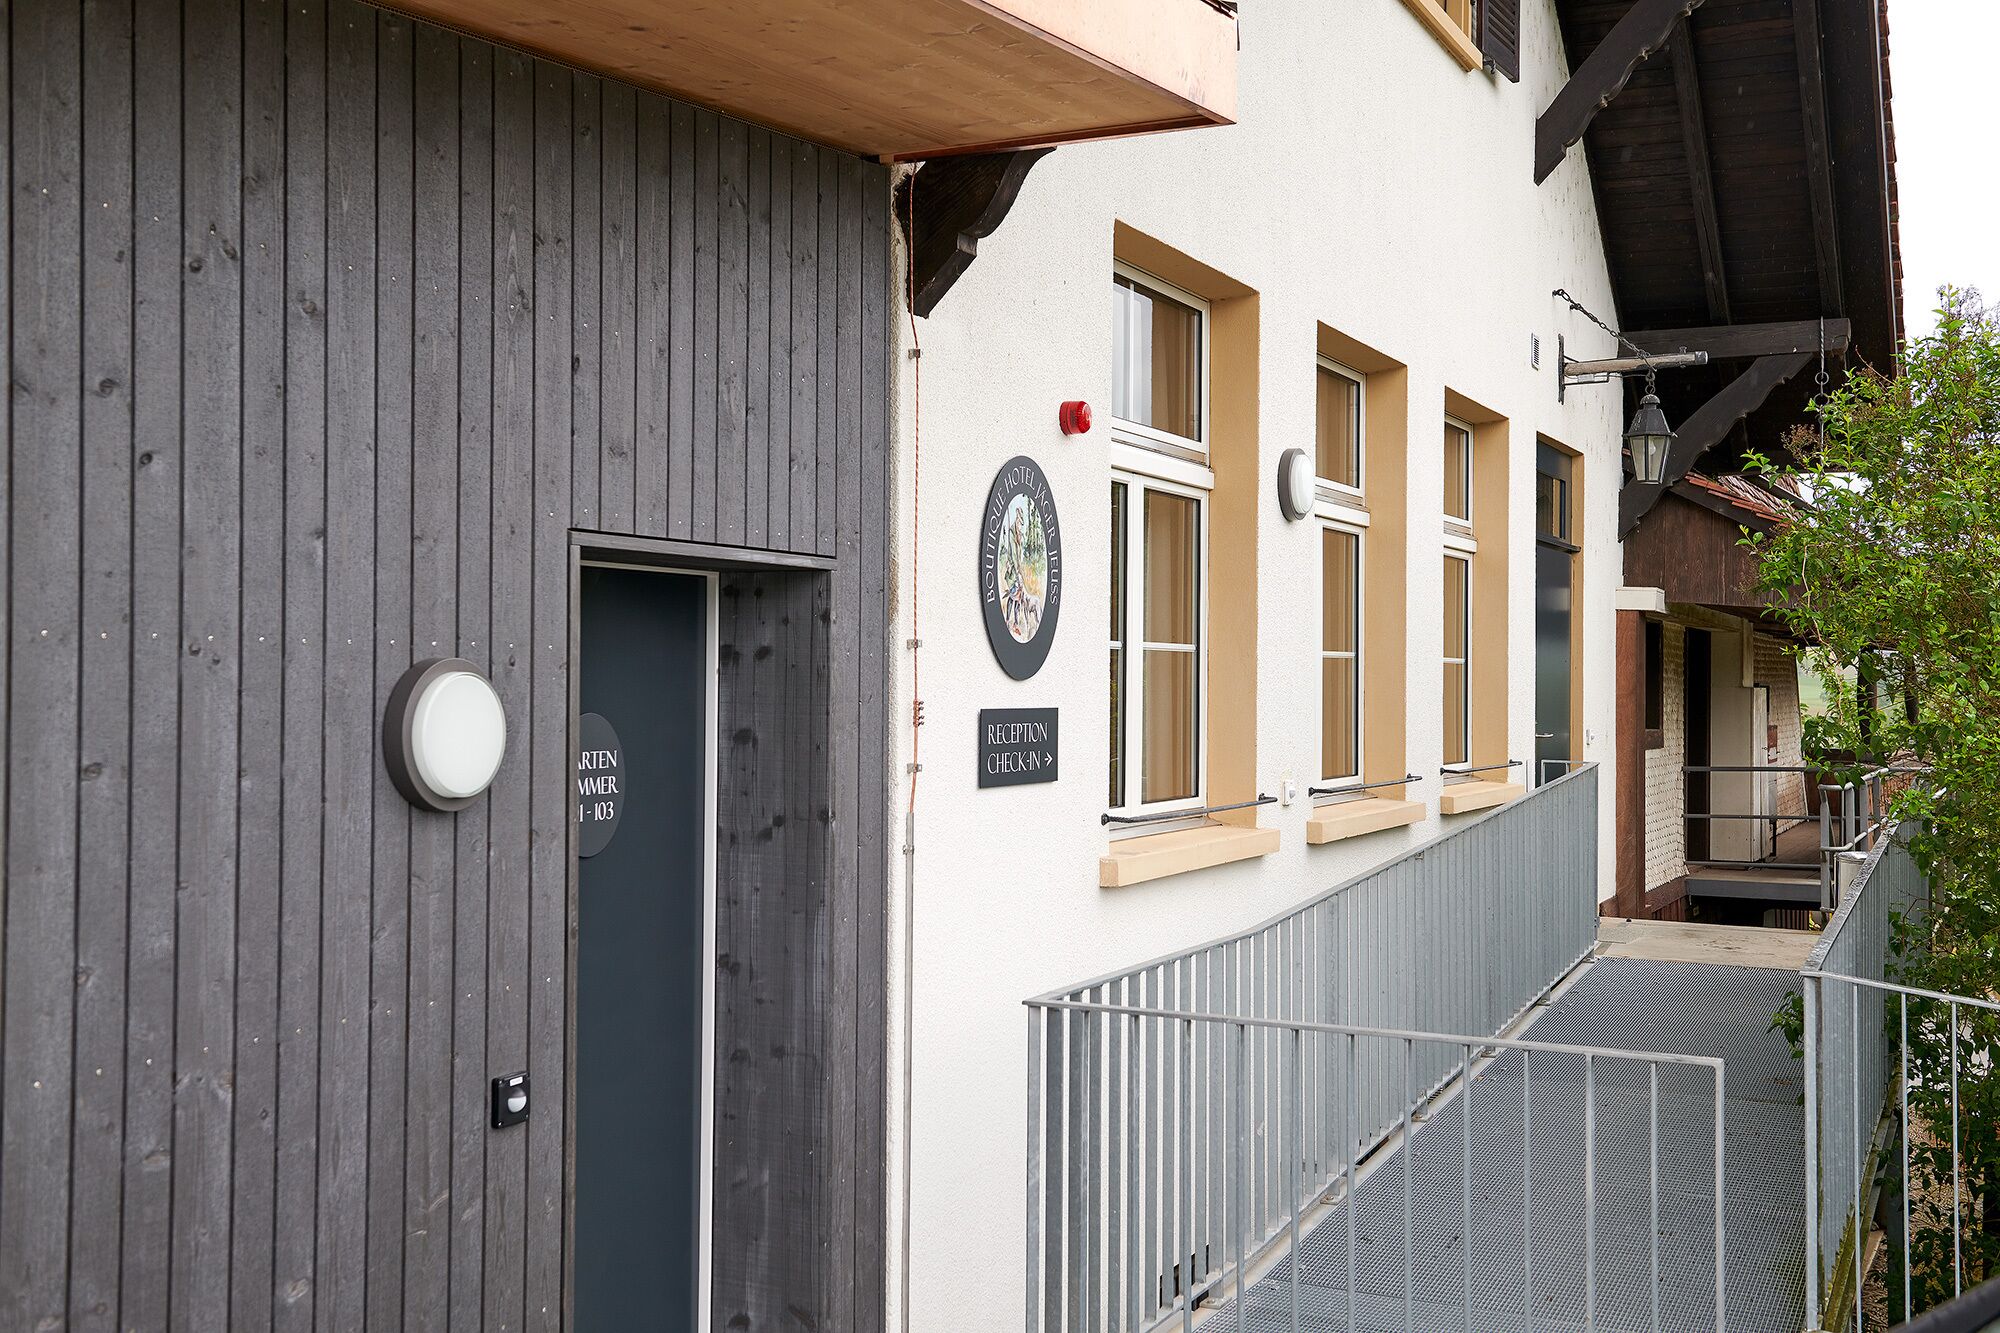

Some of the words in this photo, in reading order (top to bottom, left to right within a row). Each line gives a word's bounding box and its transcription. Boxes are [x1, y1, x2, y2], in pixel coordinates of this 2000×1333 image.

[985, 488, 1006, 603] BOUTIQUE
[1004, 465, 1035, 493] HOTEL
[1048, 550, 1059, 605] JEUSS
[988, 722, 1048, 745] RECEPTION
[987, 750, 1041, 774] CHECK-IN
[594, 801, 614, 821] 103
